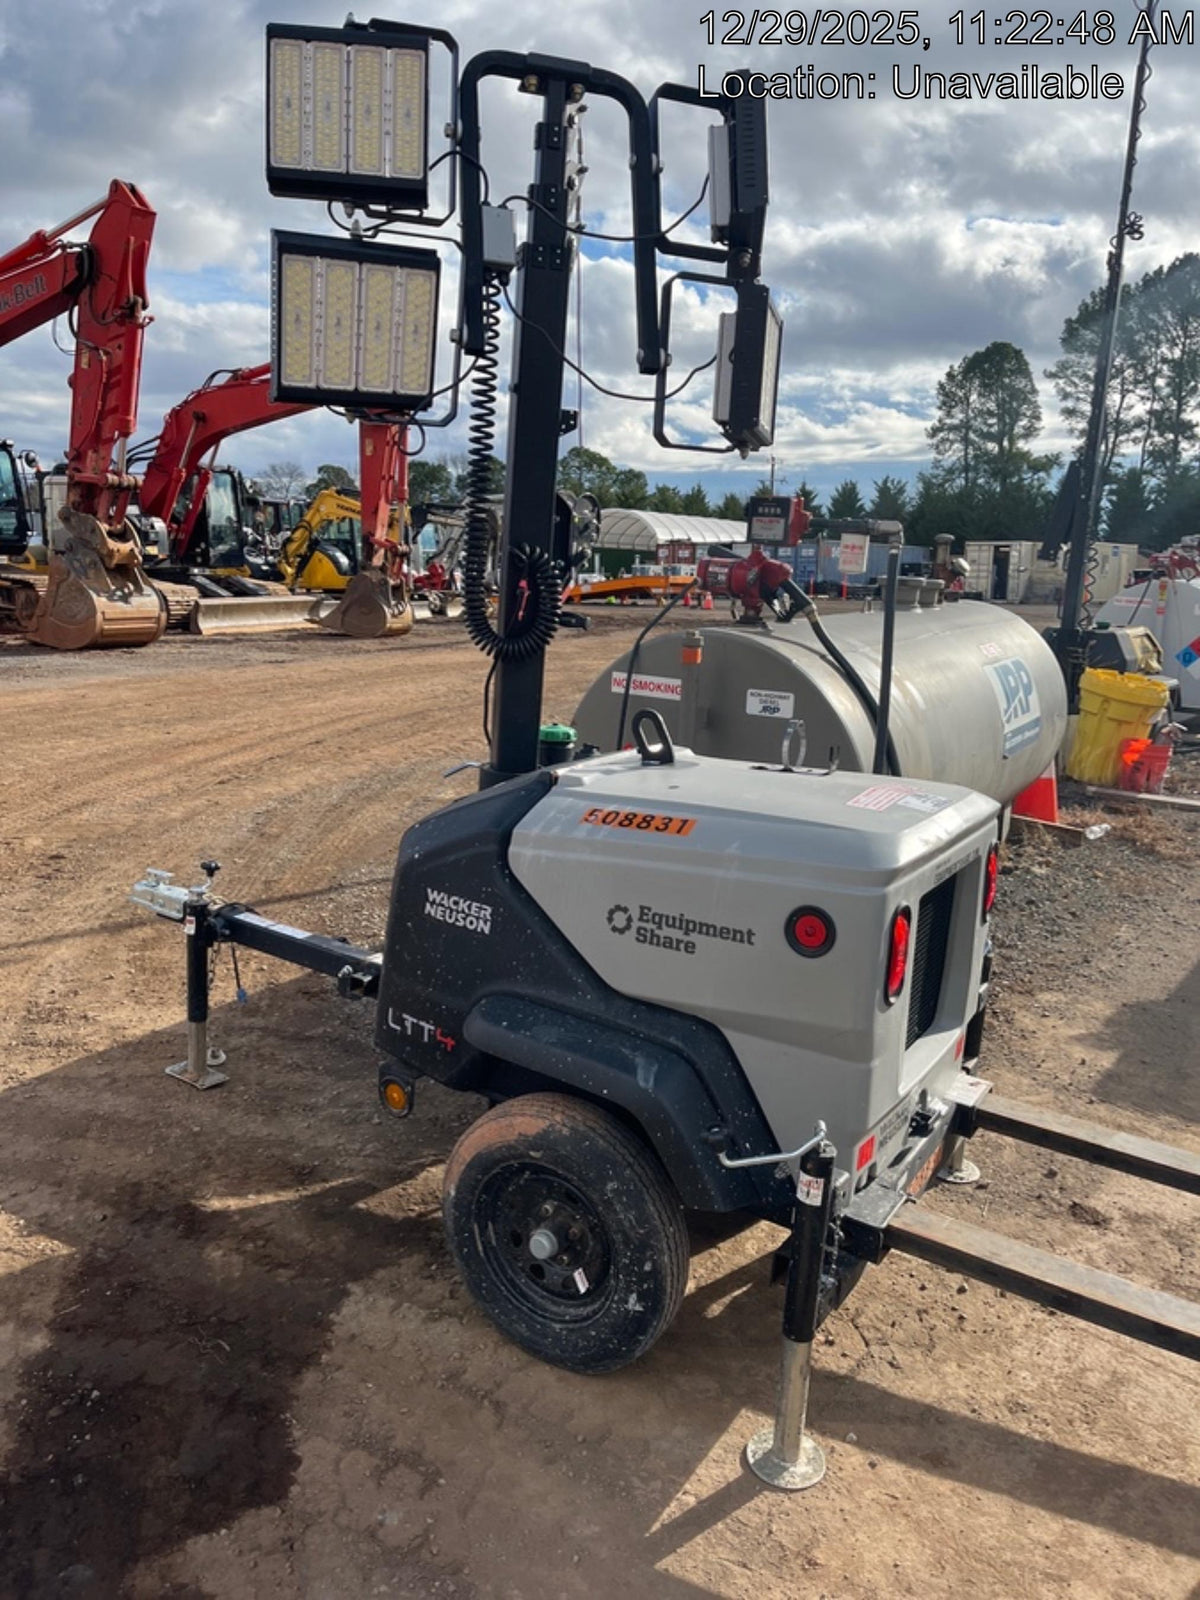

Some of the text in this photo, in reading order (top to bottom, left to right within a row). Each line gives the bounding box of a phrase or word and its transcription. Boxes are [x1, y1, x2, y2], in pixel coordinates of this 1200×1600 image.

[632, 680, 683, 695] SMOKING
[584, 808, 690, 834] 508831
[424, 902, 492, 935] NEUSON
[426, 887, 493, 920] WACKER
[635, 926, 697, 955] Share
[638, 904, 757, 946] Equipment
[388, 1007, 456, 1052] LTT4
